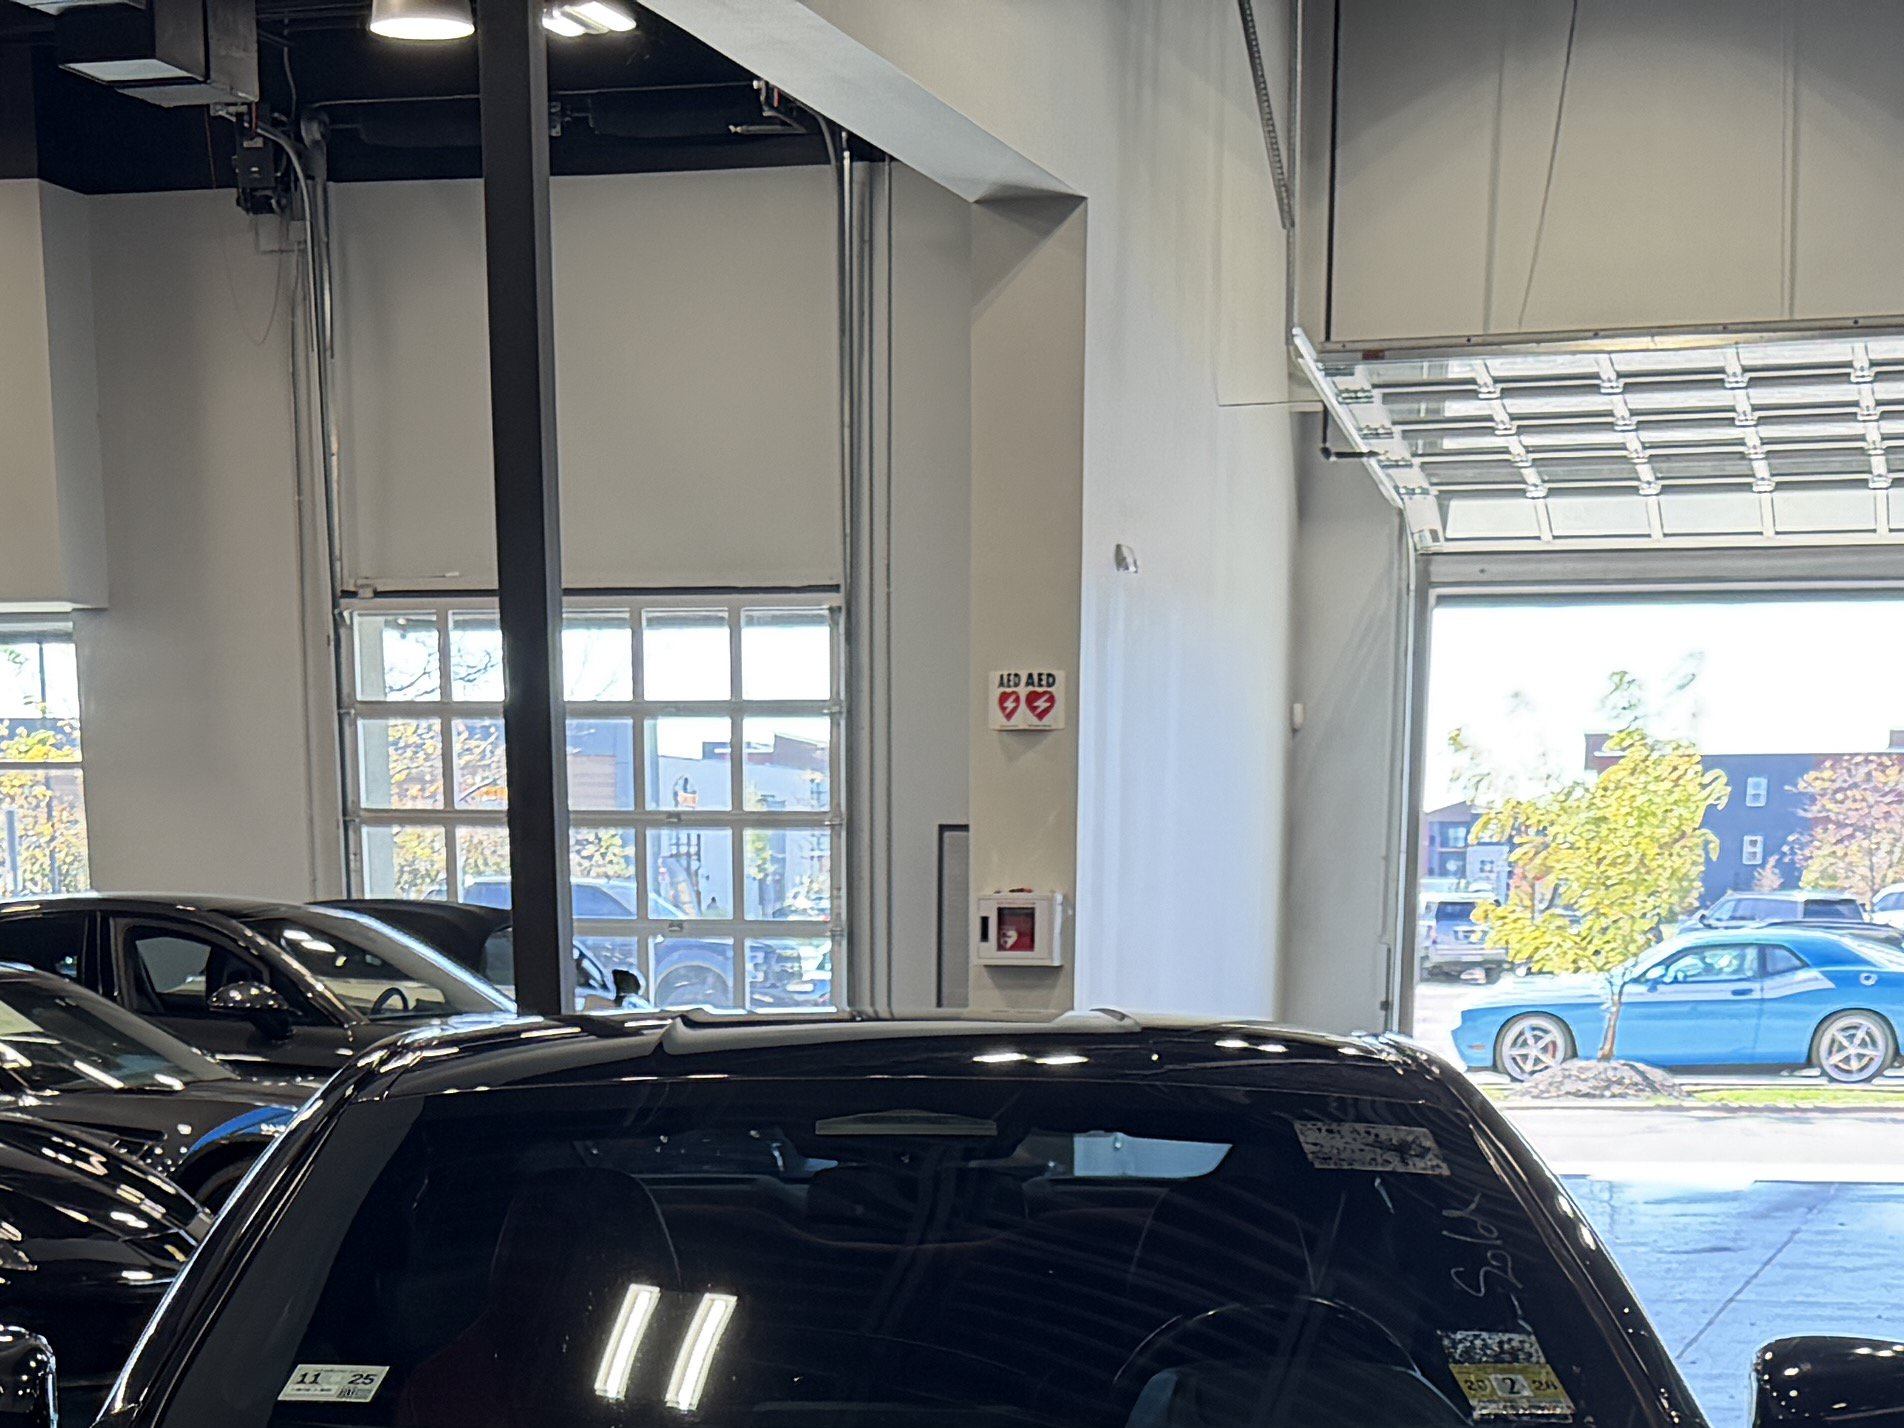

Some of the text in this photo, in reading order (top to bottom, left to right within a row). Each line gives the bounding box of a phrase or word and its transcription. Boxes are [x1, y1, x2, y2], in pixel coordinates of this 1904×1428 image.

[997, 673, 1021, 688] AED
[1025, 673, 1056, 688] AED
[296, 1372, 378, 1386] 11 25
[1502, 1376, 1521, 1395] 2
